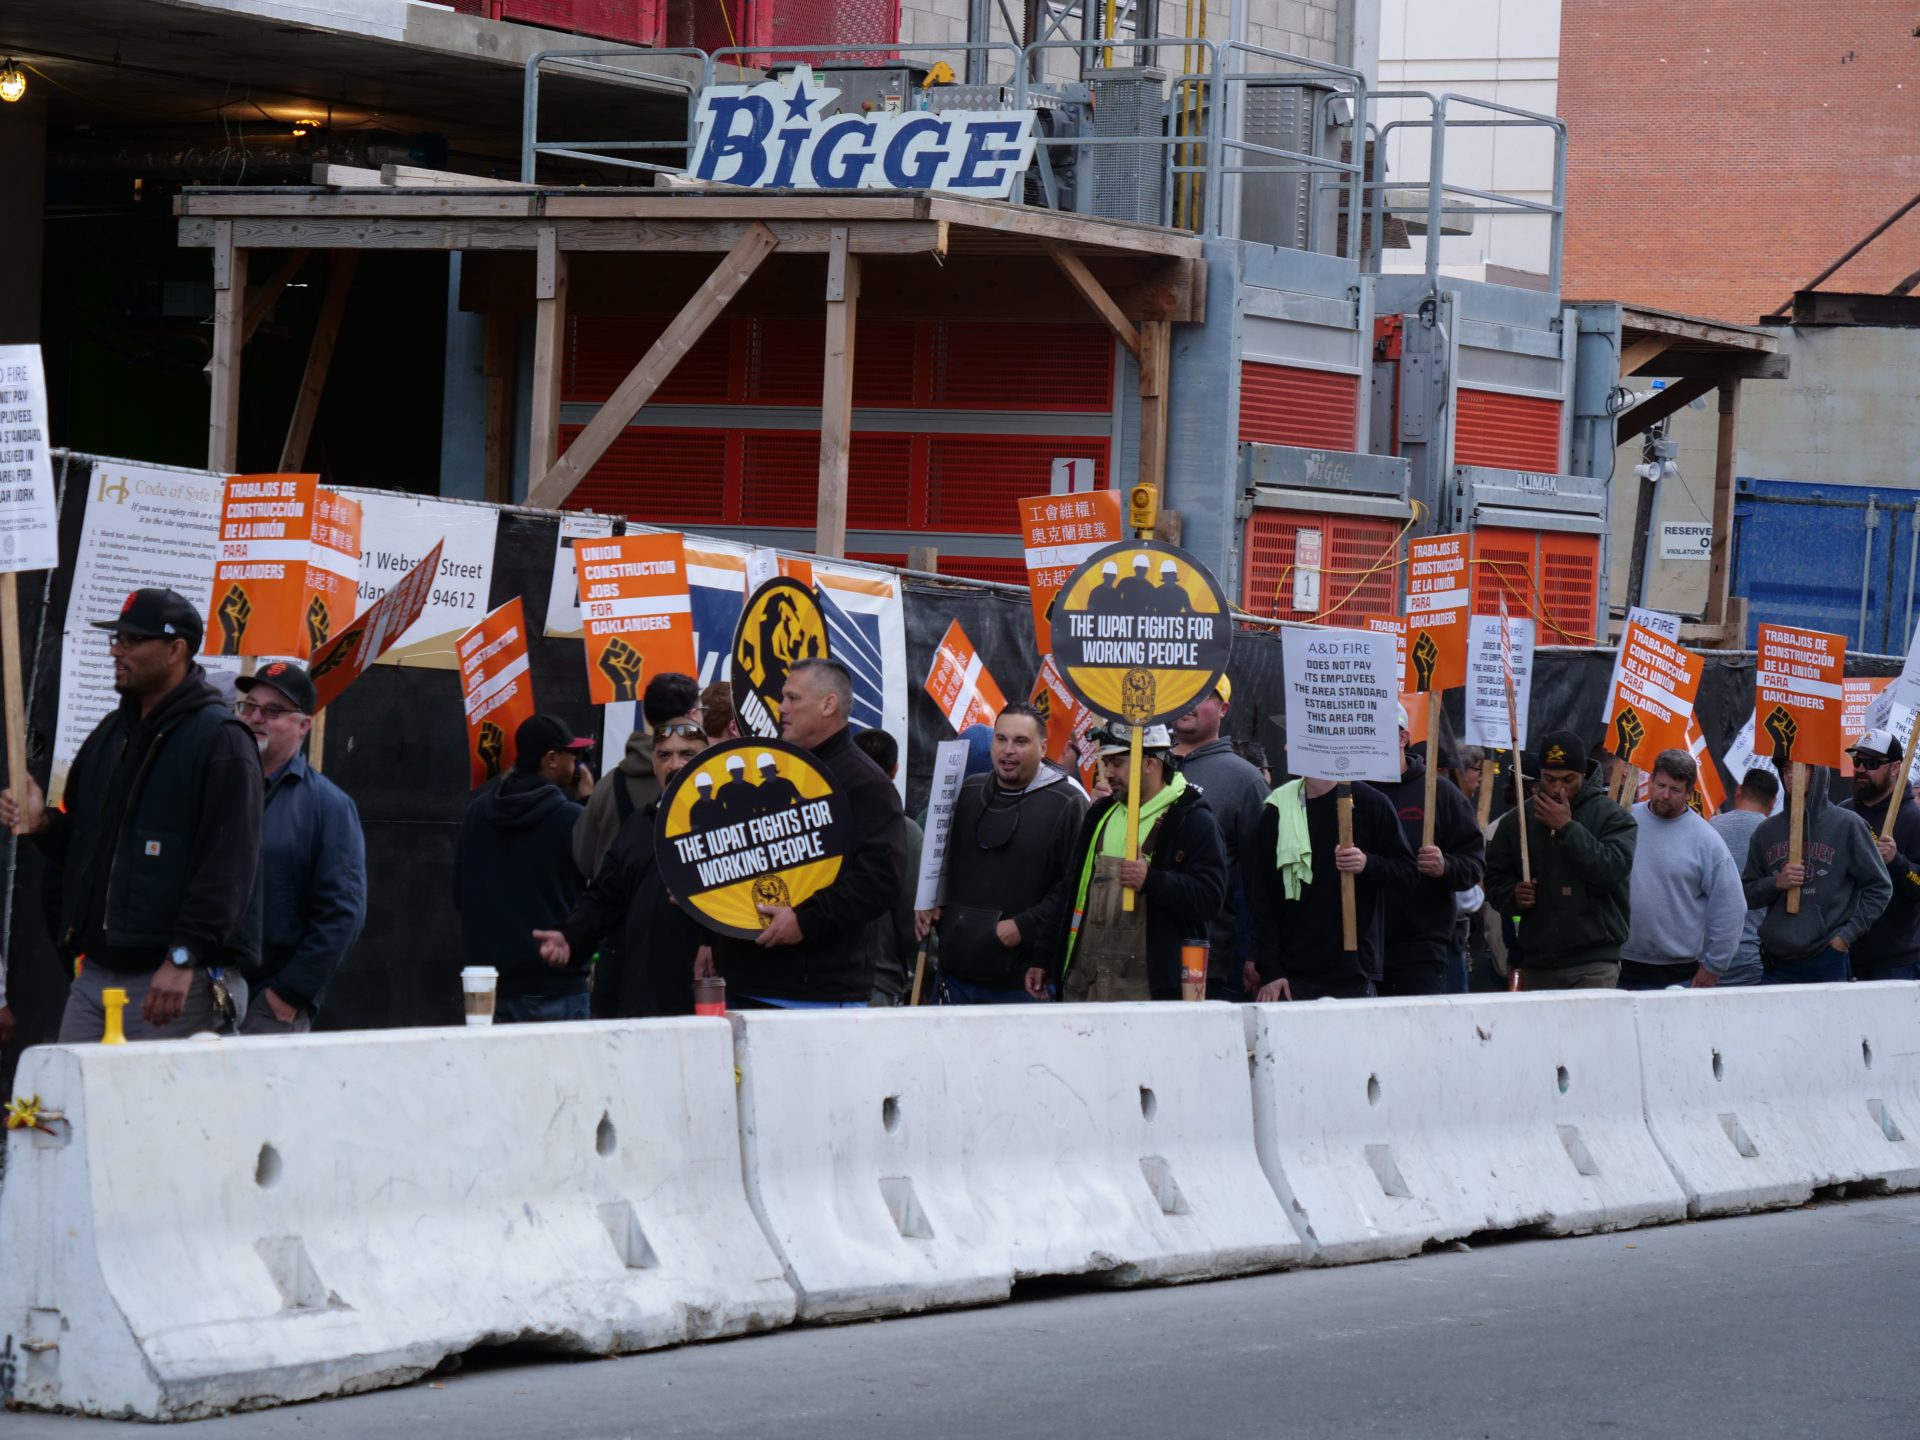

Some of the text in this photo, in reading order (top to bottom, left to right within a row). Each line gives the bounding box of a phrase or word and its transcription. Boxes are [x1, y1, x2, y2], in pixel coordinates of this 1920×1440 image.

[697, 95, 1022, 188] BIGGE
[7, 366, 28, 381] FIRE
[13, 389, 28, 402] PAY
[0, 410, 32, 423] PLOYEES
[4, 428, 41, 443] STANDARD
[1062, 460, 1076, 494] 1
[1515, 474, 1558, 492] ALIMAK
[135, 480, 168, 496] Code
[169, 481, 185, 497] of
[186, 486, 209, 502] Safe
[230, 482, 279, 498] TRABAJOS
[281, 482, 297, 496] DE
[227, 499, 305, 518] CONSTRUCCIÓN
[1028, 501, 1097, 522] 工會維權!
[224, 519, 286, 538] DE LA UNIÓN
[1031, 522, 1107, 544] 奧克蘭建築
[1664, 526, 1712, 536] RESERVE
[223, 544, 248, 558] PARA
[582, 545, 622, 561] UNION
[1413, 541, 1460, 559] TRABAJOS DE
[219, 564, 286, 580] OAKLANDERS
[377, 552, 421, 571] Webs
[440, 559, 483, 579] Street
[584, 560, 677, 580] CONSTRUCTION
[1412, 555, 1465, 576] CONSTRUCCIÓN
[1036, 568, 1076, 588] 站起
[1304, 574, 1311, 597] 1
[1412, 573, 1456, 593] DE LA UNIÓN
[432, 589, 475, 610] 94612
[587, 583, 620, 599] JOBS
[591, 603, 614, 617] FOR
[1411, 596, 1431, 610] PARA
[591, 616, 672, 635] OAKLANDERS
[1069, 614, 1214, 640] THE IUPAT FIGHTS FOR
[1370, 619, 1407, 633] TRABAJ
[1410, 611, 1456, 629] OAKLANDERS
[1651, 617, 1676, 634] FIRE
[1308, 643, 1371, 655] A&D FIRE
[1633, 629, 1687, 667] TRABAJOS DE
[1765, 629, 1828, 651] TRABAJOS DE
[1082, 640, 1198, 665] WORKING PEOPLE
[1764, 645, 1835, 667] CONSTRUCCIÓN
[1306, 659, 1372, 671] DOES NOT PAY
[1629, 643, 1691, 684] CONSTRUCCIÓN
[1764, 659, 1820, 680] DE LA UNIÓN
[1304, 672, 1376, 684] ITS EMPLOYEES
[1623, 672, 1644, 692] PARA
[1626, 658, 1676, 693] DE LA UNIÓN
[1763, 674, 1789, 688] PARA
[1294, 683, 1388, 699] THE AREA STANDARD
[1844, 682, 1871, 691] UNION
[1305, 698, 1377, 710] ESTABLISHED IN
[1620, 687, 1672, 724] OAKLANDERS
[1762, 690, 1824, 710] OAKLANDERS
[1307, 711, 1374, 723] THIS AREA FOR
[1844, 705, 1867, 714] JOBS
[1846, 716, 1861, 725] FOR
[1895, 721, 1908, 734] THE
[1307, 724, 1376, 736] SIMILAR WORK
[674, 800, 833, 864] THE IUPAT FIGHTS FOR
[697, 831, 825, 887] WORKING PEOPLE
